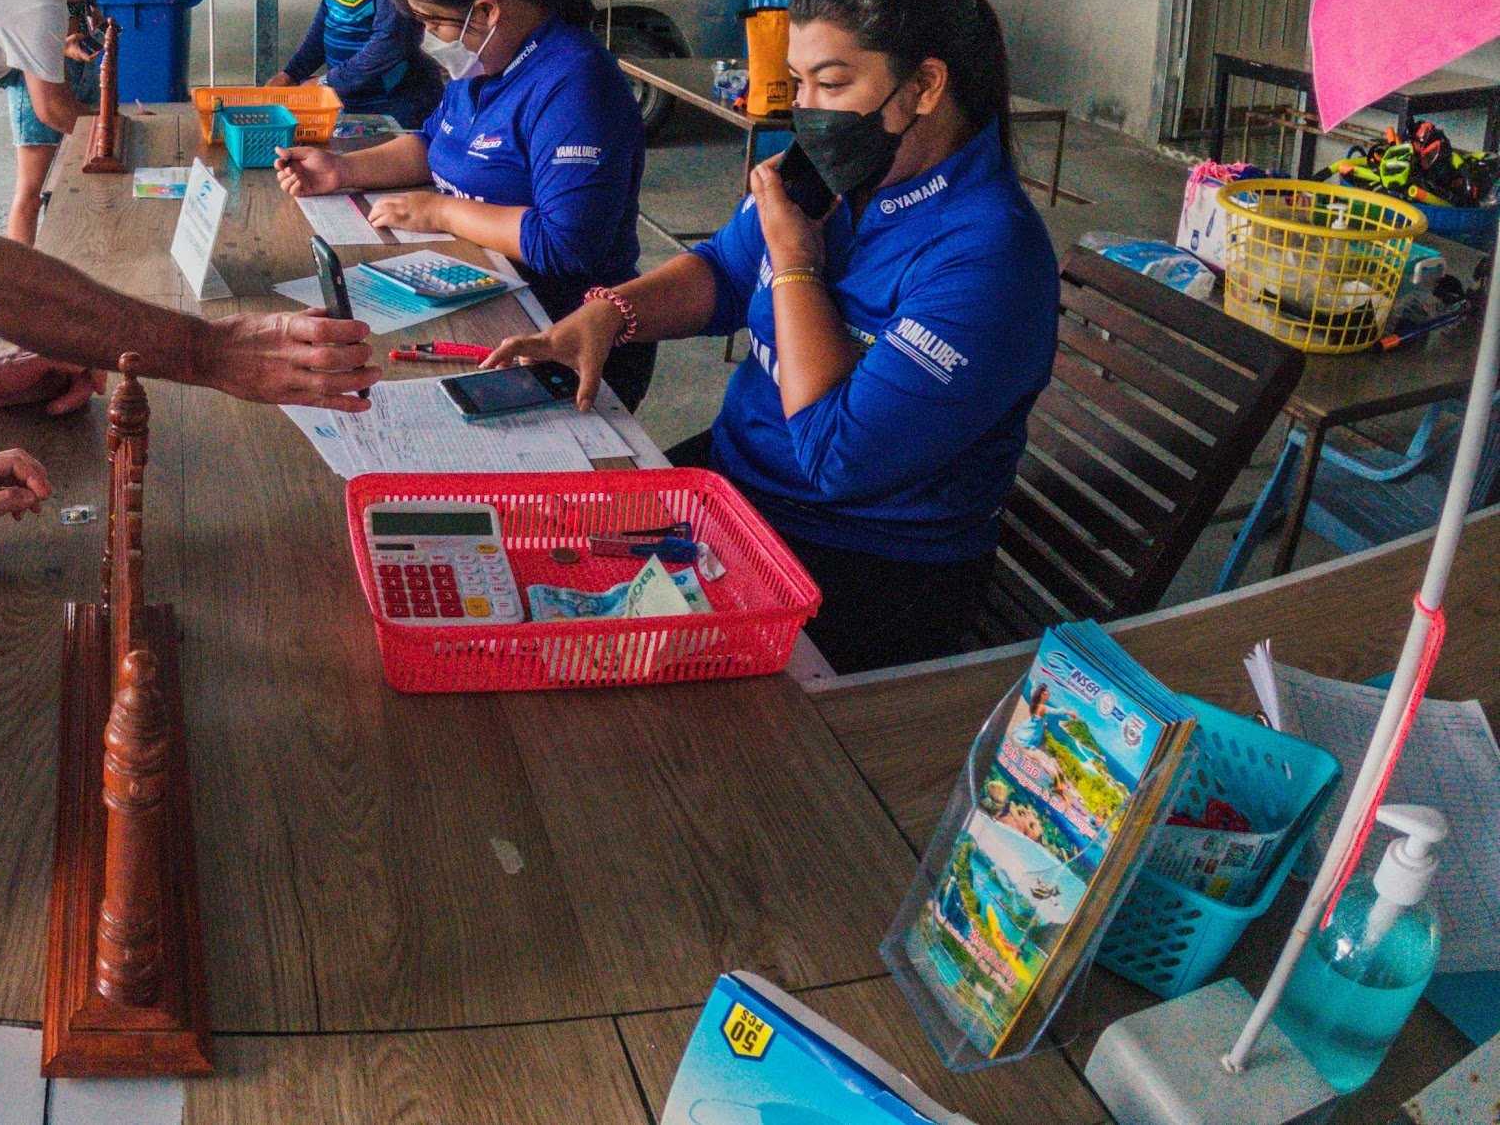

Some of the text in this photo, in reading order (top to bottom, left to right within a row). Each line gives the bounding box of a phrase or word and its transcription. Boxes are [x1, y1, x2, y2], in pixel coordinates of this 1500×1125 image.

[556, 146, 598, 158] YAMALUBE
[895, 174, 948, 209] YAMAHA
[896, 317, 961, 373] YAMALUBE
[386, 565, 446, 574] 7 8 9
[389, 579, 449, 587] 4 5 6
[419, 592, 426, 601] 2
[445, 592, 453, 601] 3
[1071, 670, 1101, 696] INSEA
[1003, 740, 1040, 778] Koh Tao
[741, 1010, 765, 1033] PCS
[730, 1020, 759, 1053] 50
